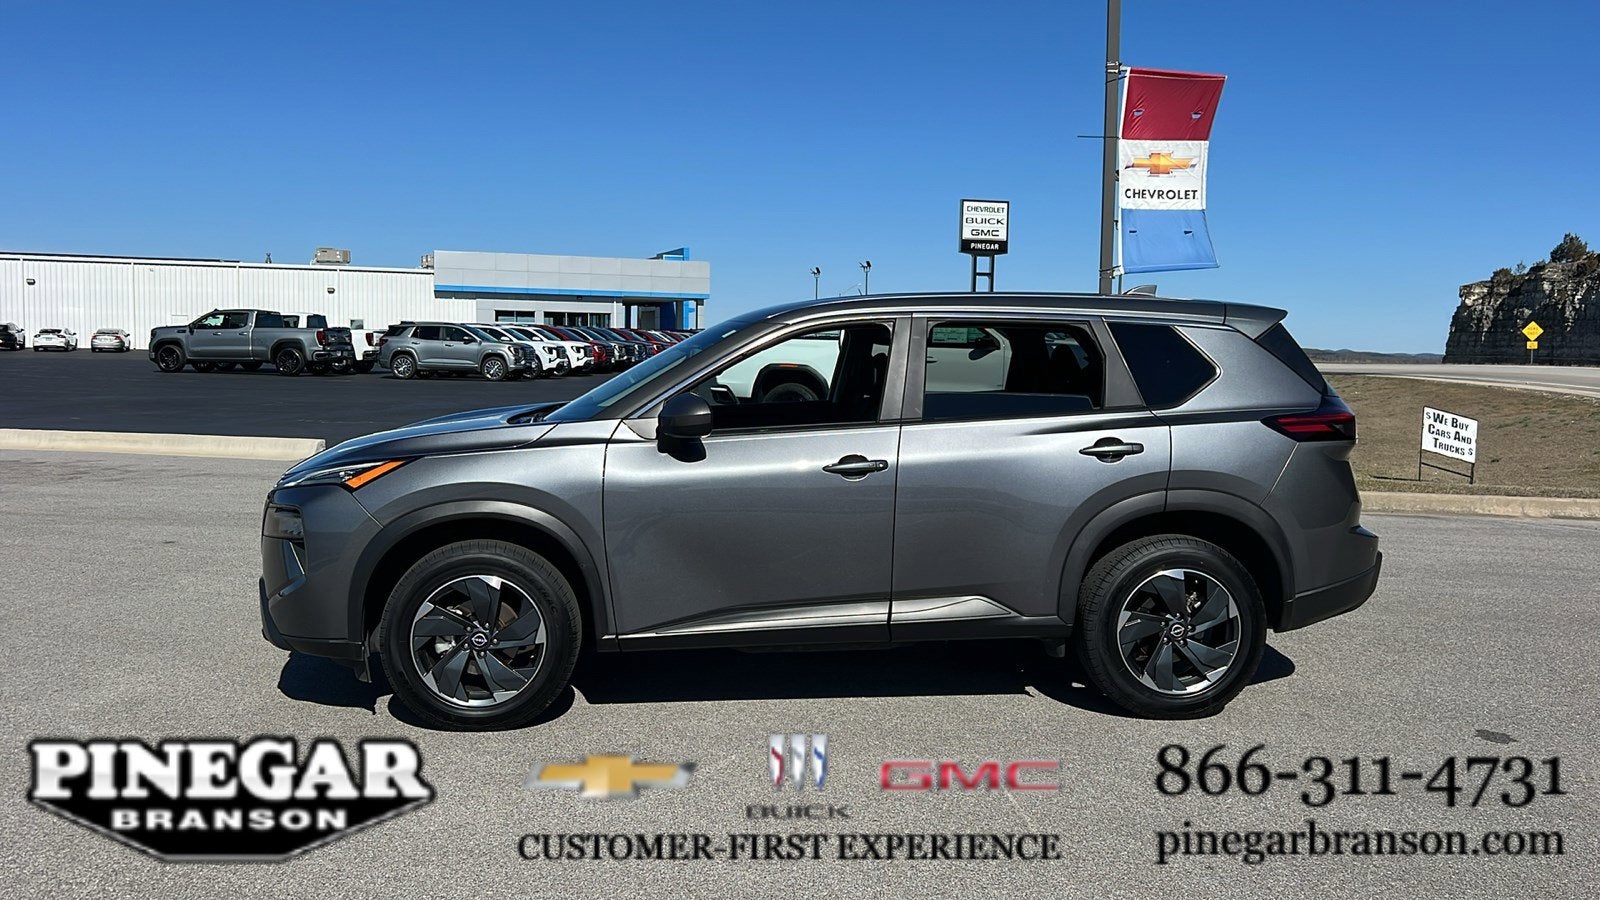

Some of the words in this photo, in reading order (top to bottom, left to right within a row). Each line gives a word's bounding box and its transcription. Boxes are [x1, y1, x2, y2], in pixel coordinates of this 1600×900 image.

[1124, 188, 1198, 200] CHEVROLET
[966, 205, 1005, 214] CHEVROLET
[965, 217, 1005, 225] BUICK
[970, 229, 1000, 237] GMC
[970, 242, 1000, 250] PINEGAR
[1451, 417, 1469, 431] BUY
[1428, 423, 1451, 439] CARS
[1453, 431, 1472, 445] AND
[1433, 437, 1465, 456] TRUCKS
